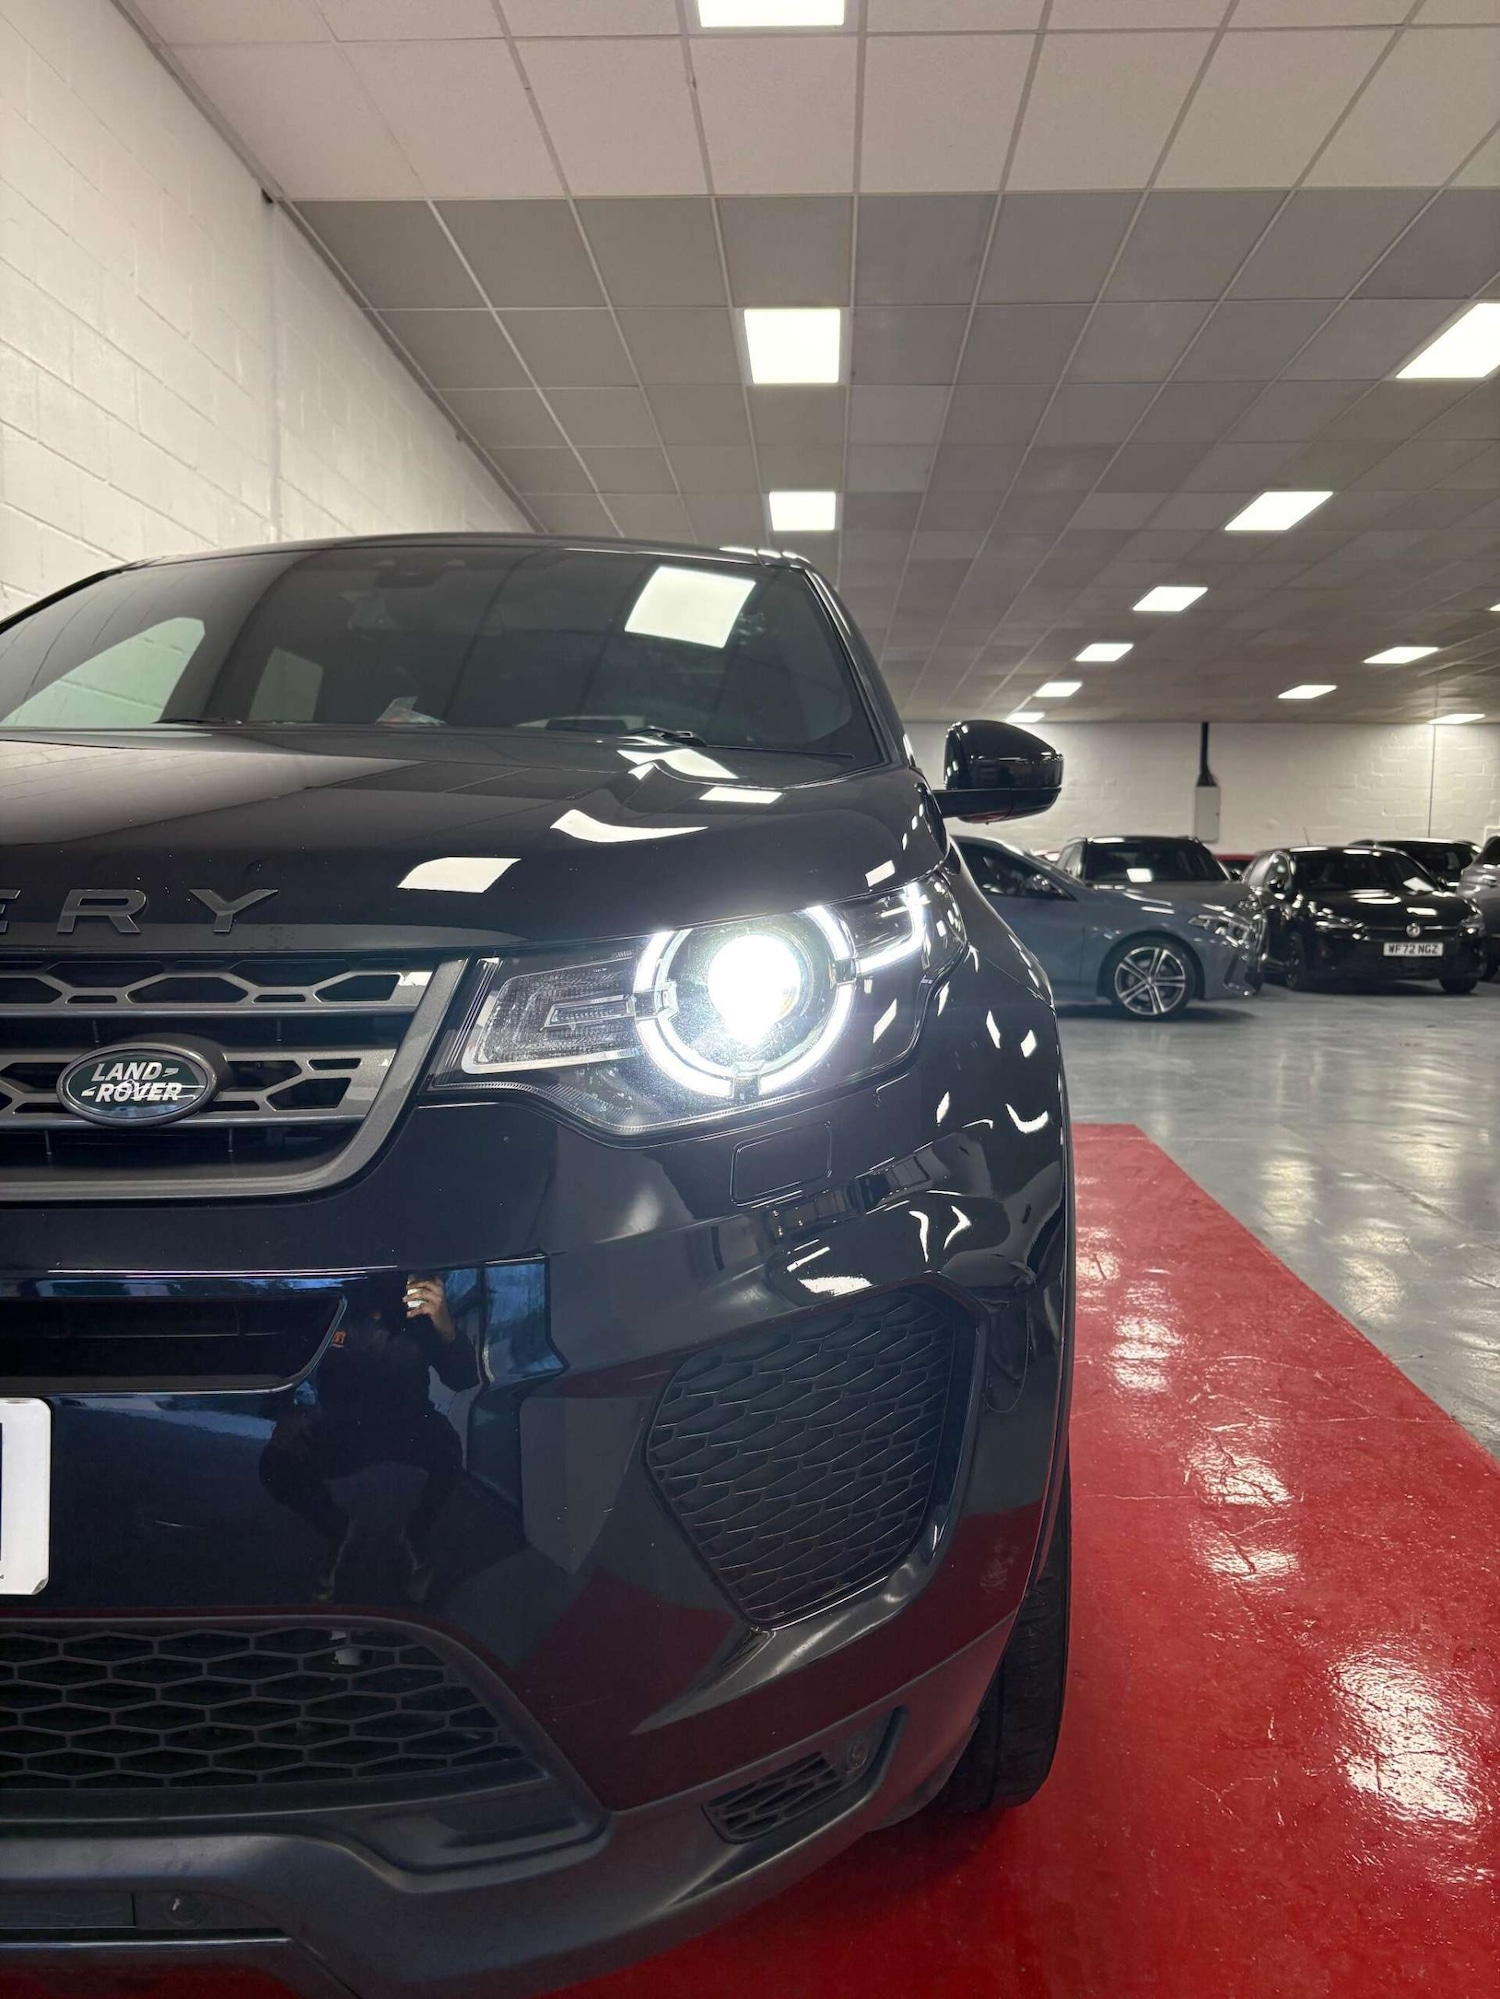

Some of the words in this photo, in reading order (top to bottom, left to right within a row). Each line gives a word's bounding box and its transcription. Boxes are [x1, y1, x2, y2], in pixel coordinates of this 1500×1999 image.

[0, 888, 279, 934] RY
[1389, 943, 1415, 954] WF72
[1418, 943, 1438, 954] NGZ
[91, 1062, 163, 1082] LAND
[95, 1082, 183, 1103] ROVER
